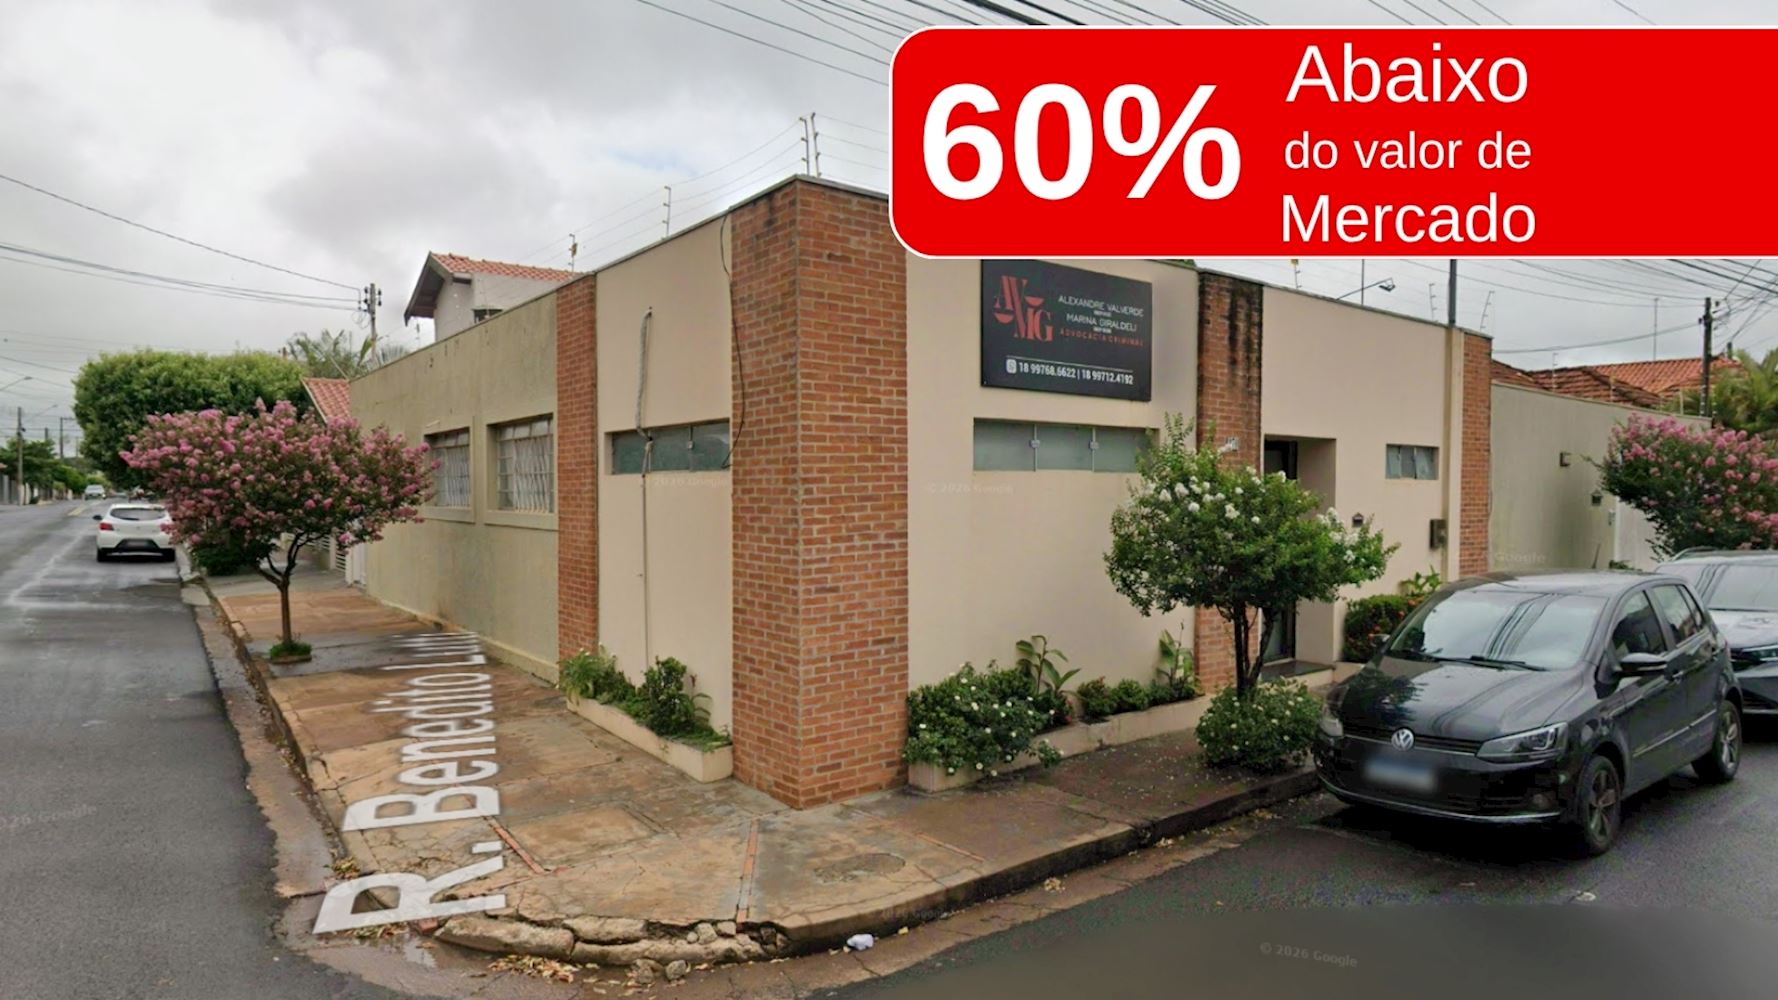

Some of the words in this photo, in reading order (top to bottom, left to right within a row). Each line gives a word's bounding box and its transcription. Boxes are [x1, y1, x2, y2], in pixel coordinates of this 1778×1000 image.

[1058, 295, 1105, 311] ALEXANDRE
[1107, 303, 1144, 318] VALVERDE
[1066, 312, 1098, 326] MARINA
[1060, 327, 1107, 341] ADVOCACIA
[1019, 362, 1029, 373] 18
[1081, 369, 1091, 380] 18
